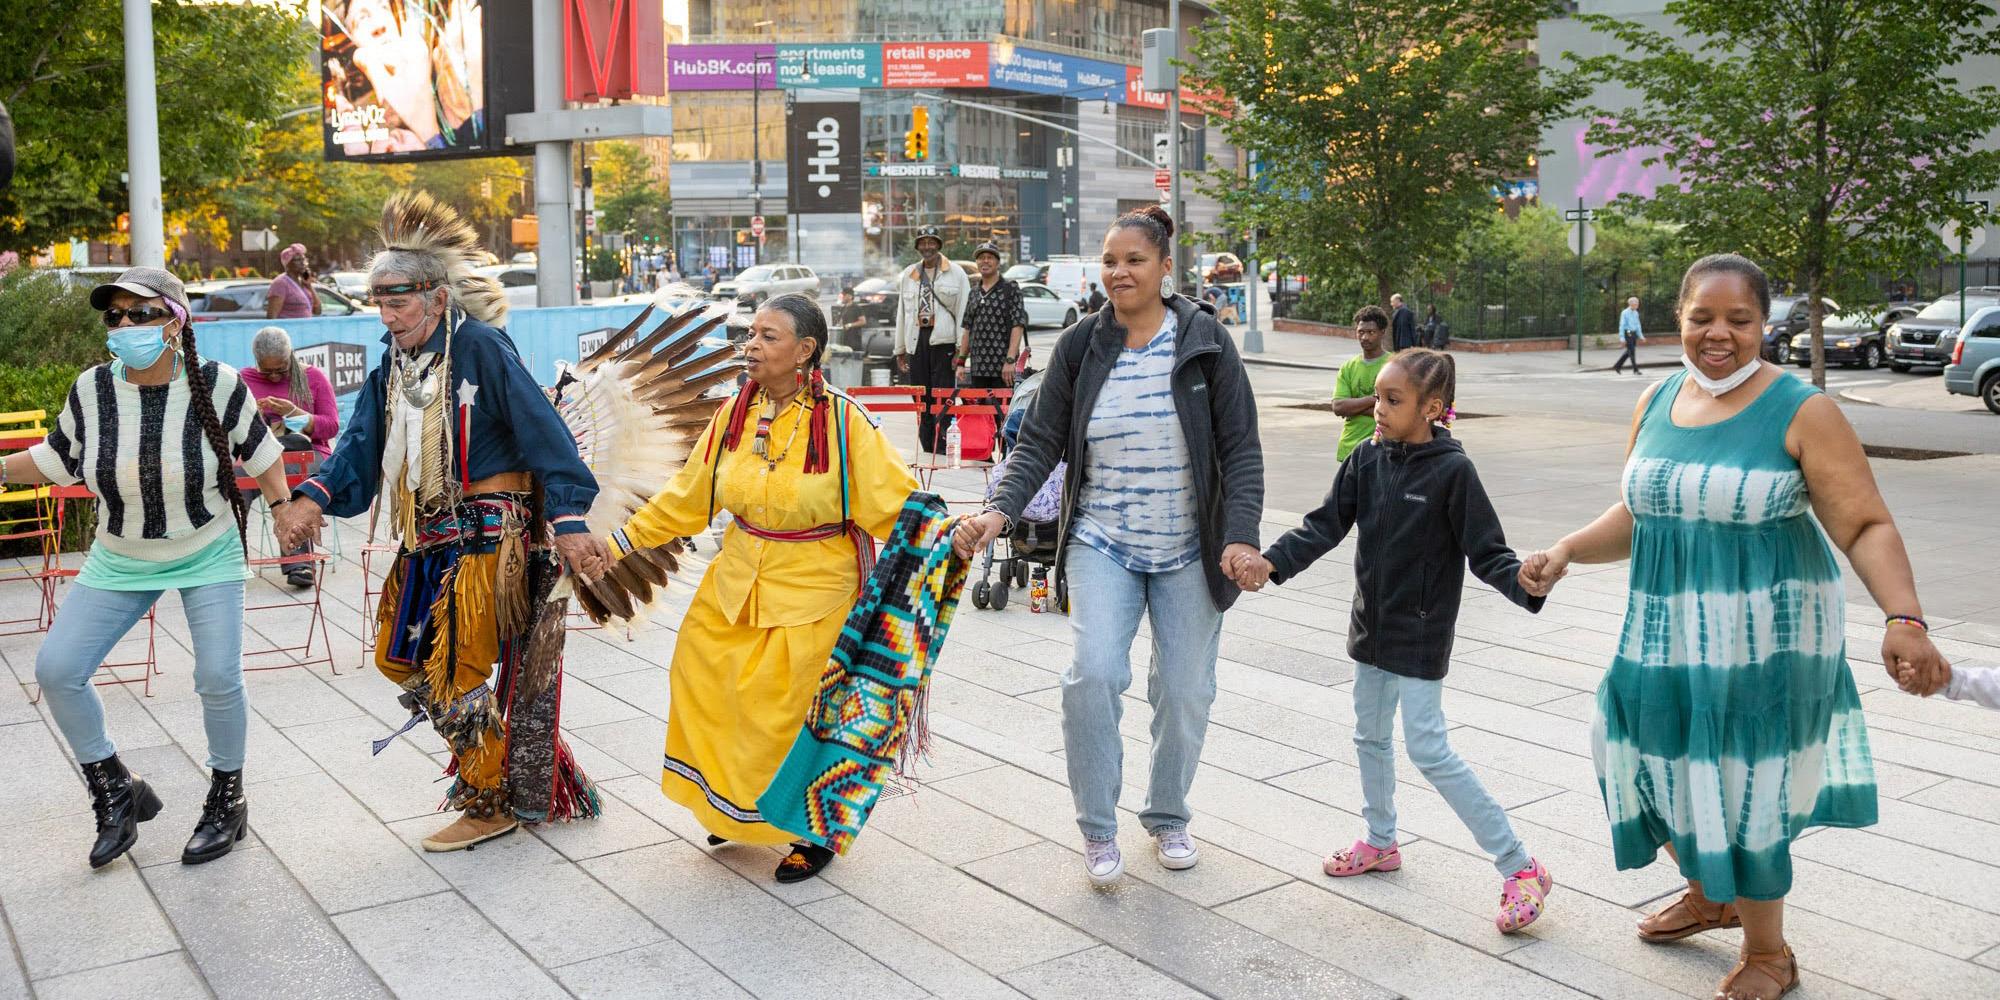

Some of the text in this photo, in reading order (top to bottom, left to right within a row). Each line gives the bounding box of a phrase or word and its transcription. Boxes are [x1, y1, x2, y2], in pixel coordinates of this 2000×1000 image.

[780, 47, 865, 63] apartments
[886, 46, 972, 62] retail space
[673, 59, 772, 76] HubBK.com
[813, 63, 866, 79] leasing
[1022, 57, 1047, 71] square
[1048, 59, 1063, 73] feet
[995, 67, 1068, 88] of private amenities
[880, 165, 936, 177] MEDRITE
[959, 165, 1049, 179] MEDRITE URGENT CARE
[334, 352, 362, 367] BRK
[336, 369, 363, 387] LYN
